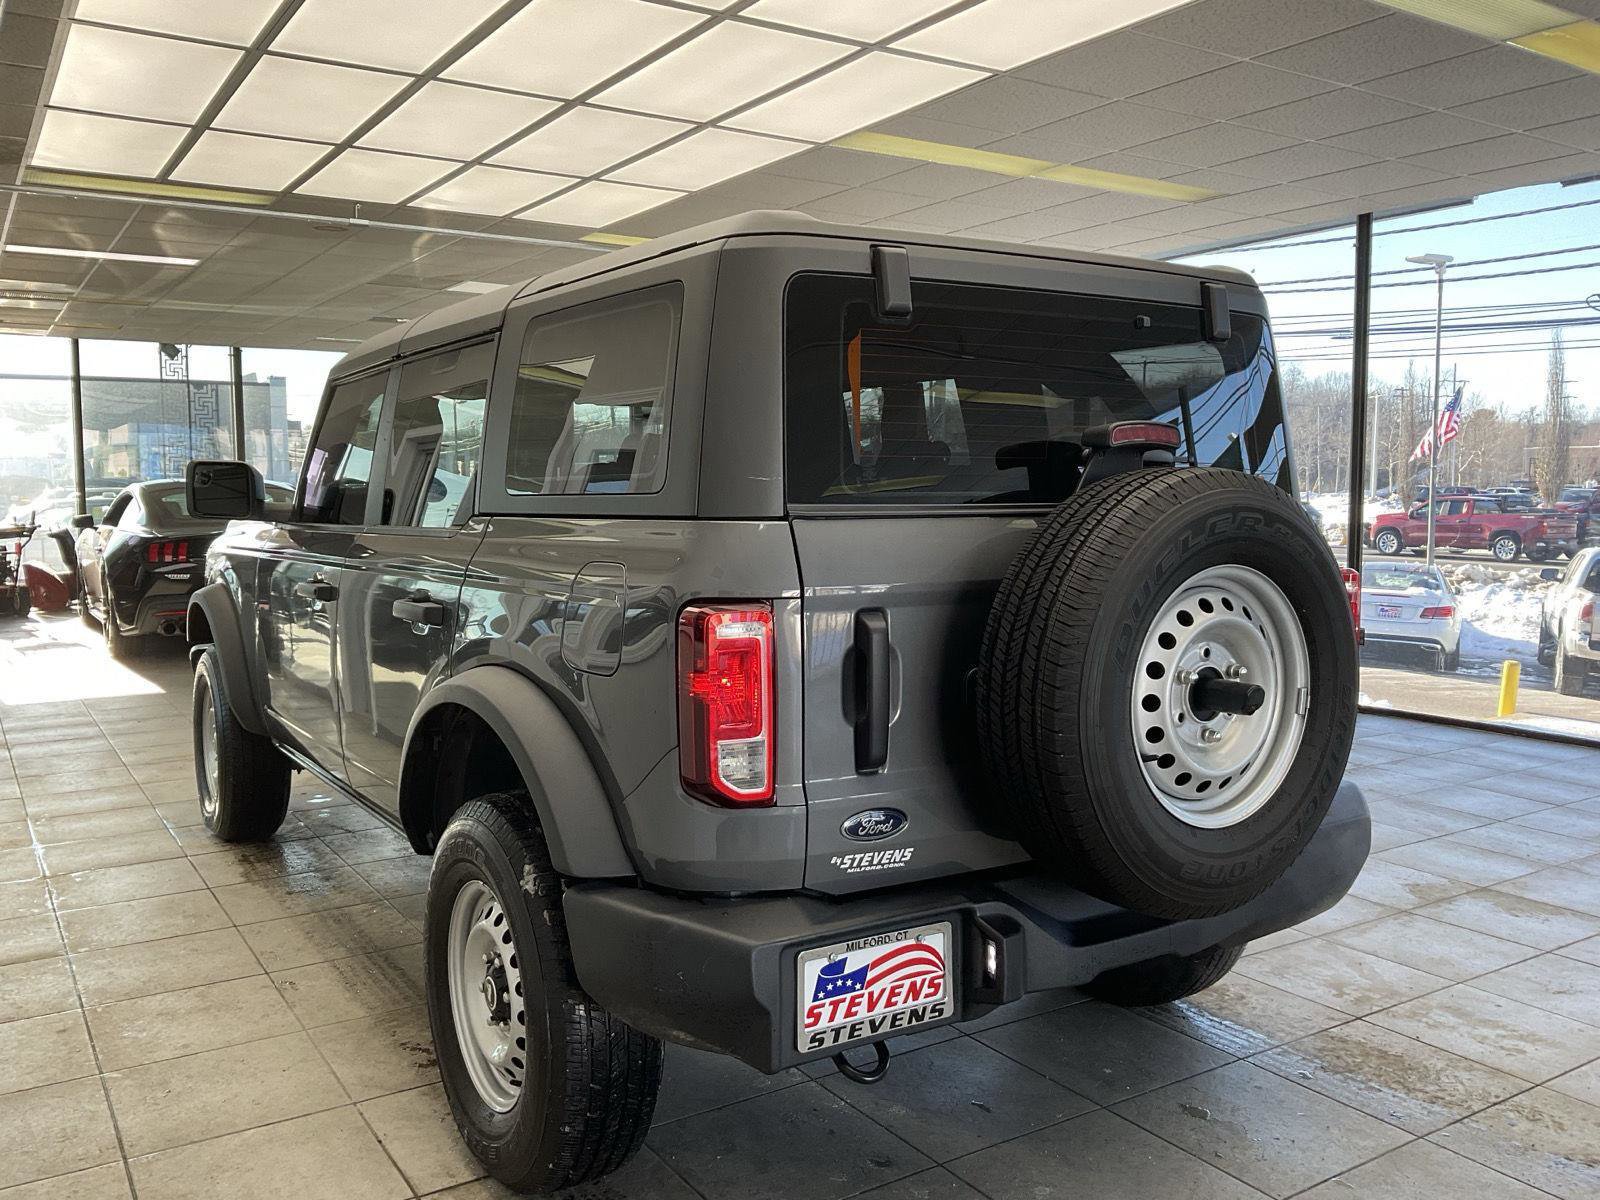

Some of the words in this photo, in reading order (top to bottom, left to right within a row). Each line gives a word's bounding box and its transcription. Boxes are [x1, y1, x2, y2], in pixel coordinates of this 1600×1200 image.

[858, 817, 893, 835] Ford
[840, 848, 914, 868] STEVENS
[896, 931, 909, 941] CT
[805, 972, 945, 1028] STEVENS
[807, 1002, 946, 1050] STEVENS
